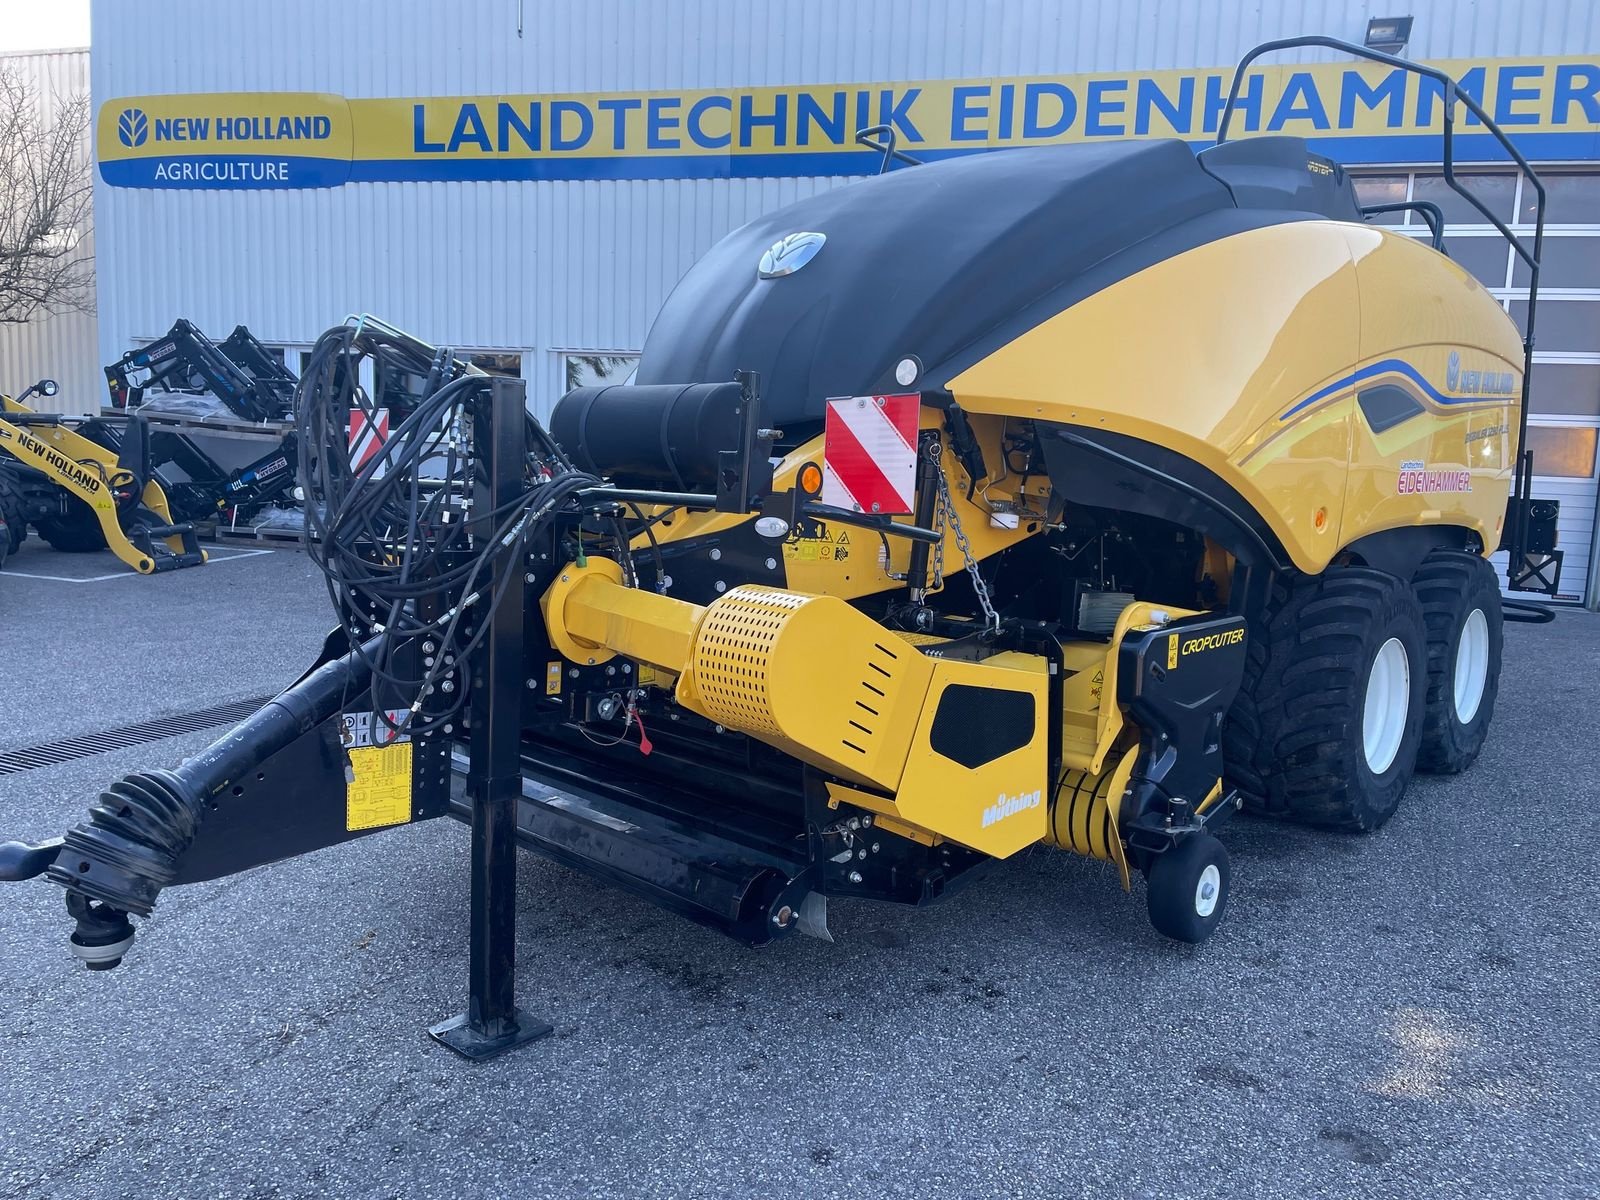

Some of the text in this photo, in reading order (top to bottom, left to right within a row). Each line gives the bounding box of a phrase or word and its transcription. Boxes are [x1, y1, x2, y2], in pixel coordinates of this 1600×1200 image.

[413, 64, 1600, 153] LANDTECHNIK EIDENHAMMER
[155, 116, 331, 141] NEW HOLLAND
[154, 162, 289, 182] AGRICULTURE
[1460, 370, 1514, 394] NEW HOLLAND
[17, 433, 100, 492] NEW HOLLAND
[260, 461, 286, 477] HYDRAC
[56, 469, 96, 495] LONG REACH
[1398, 471, 1471, 494] EIDENHAMMER
[1182, 628, 1245, 656] CROPCUTTER
